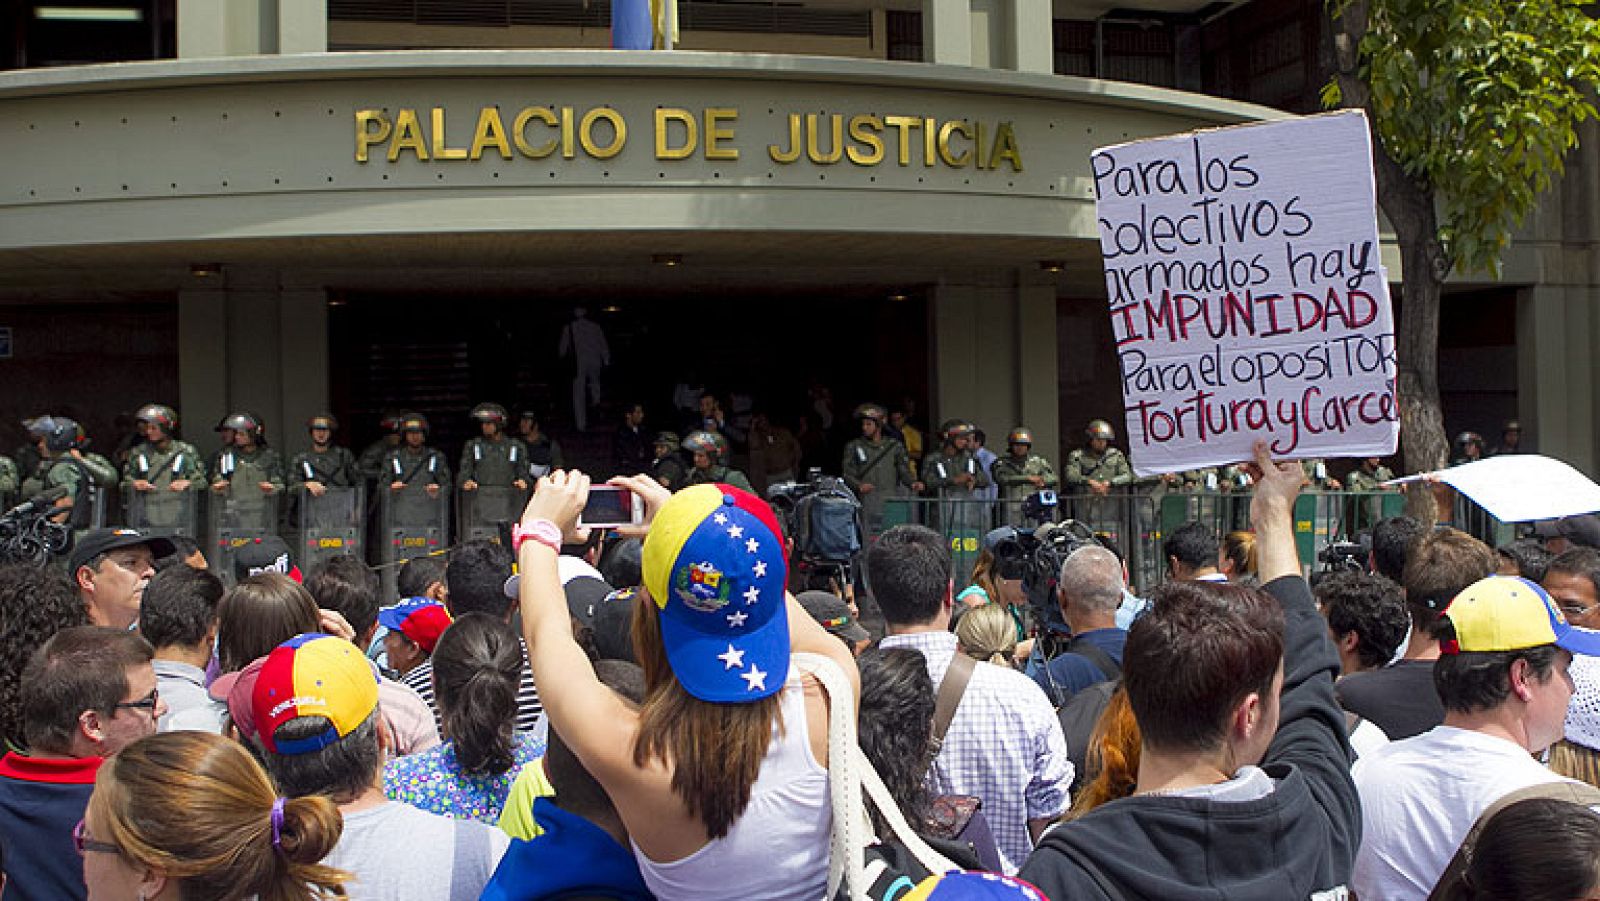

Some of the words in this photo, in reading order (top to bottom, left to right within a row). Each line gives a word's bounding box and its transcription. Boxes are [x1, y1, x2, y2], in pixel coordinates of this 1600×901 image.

[354, 106, 627, 163] PALACIO
[653, 107, 739, 161] DE
[767, 113, 1023, 172] JUSTICIA
[1089, 151, 1188, 200] Para
[1193, 137, 1259, 194] los
[1287, 241, 1376, 290] hay
[1110, 287, 1378, 347] IMPUNIDAD
[1119, 349, 1197, 396] Para
[1199, 343, 1228, 387] el
[1271, 398, 1299, 454] y
